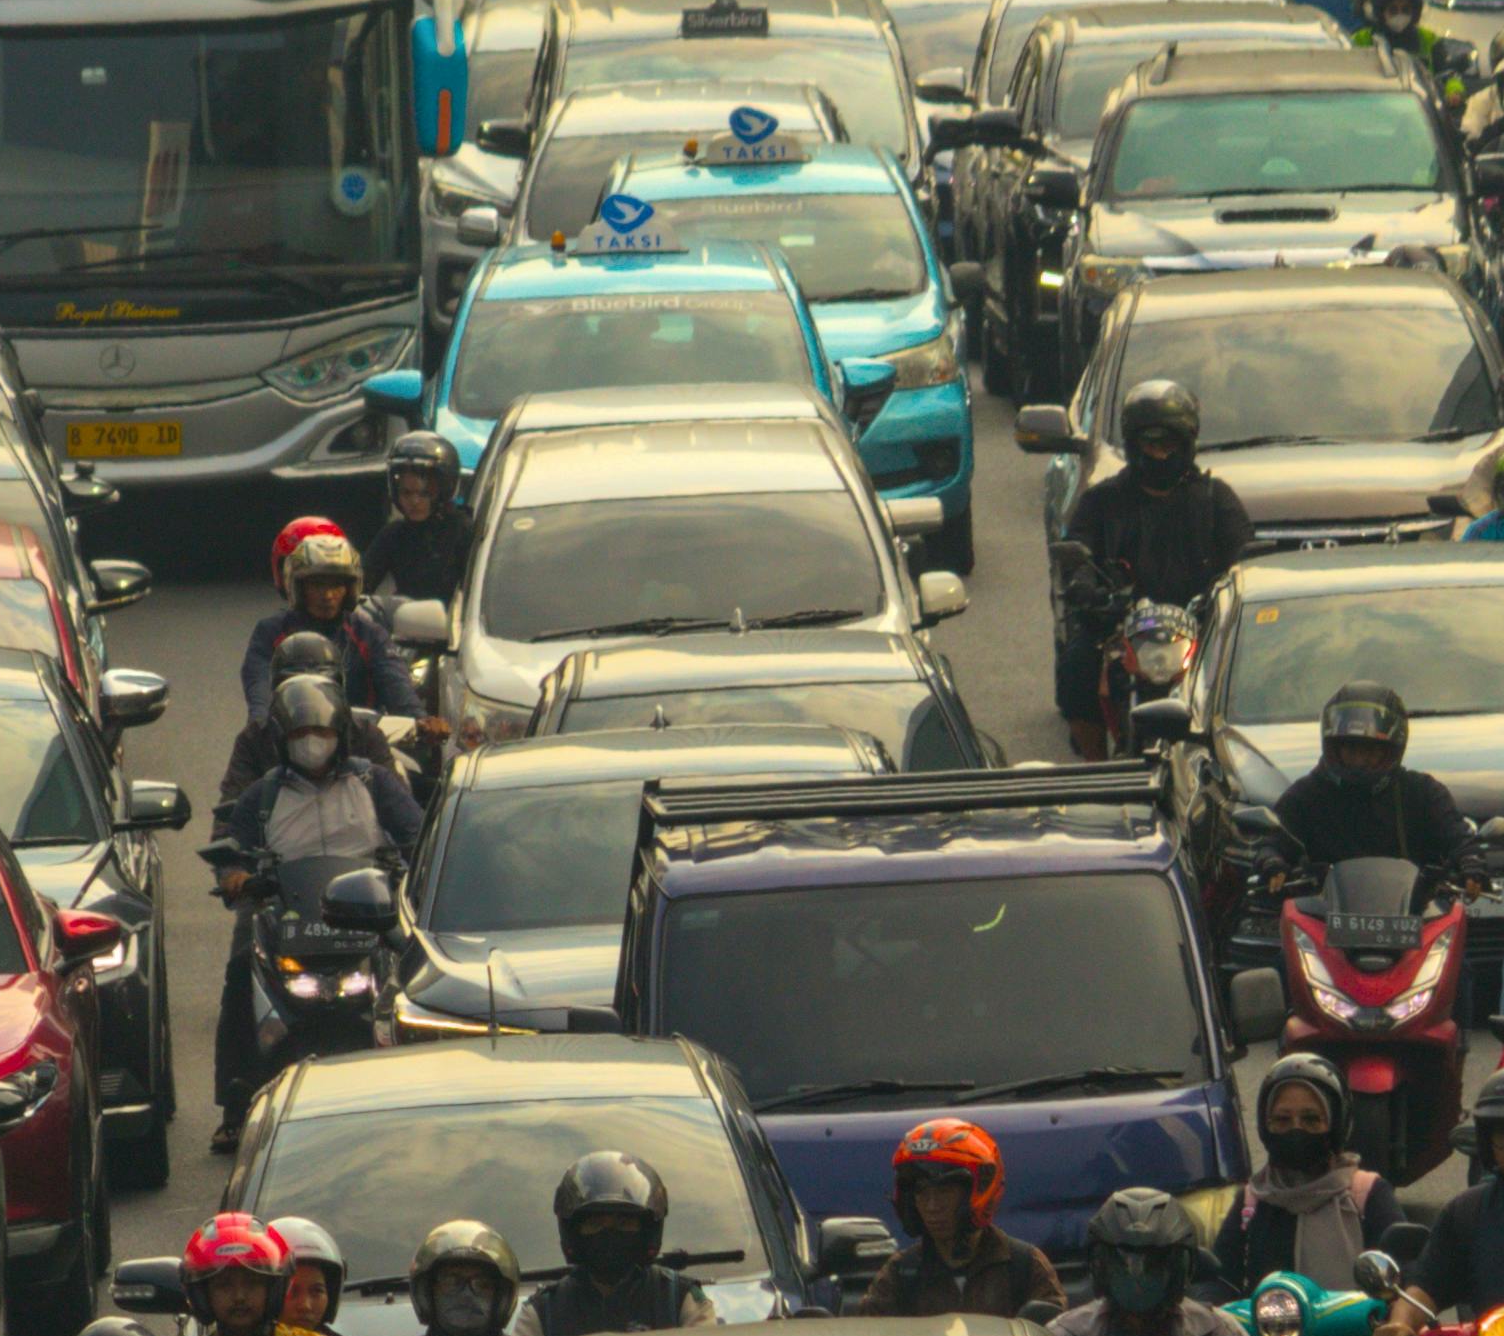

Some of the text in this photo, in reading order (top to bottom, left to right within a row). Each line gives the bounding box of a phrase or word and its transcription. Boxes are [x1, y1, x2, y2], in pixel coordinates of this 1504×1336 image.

[687, 11, 763, 30] Silverbird
[722, 144, 786, 159] TAKSI
[594, 234, 661, 249] TAKSI
[572, 294, 681, 313] Bluebird
